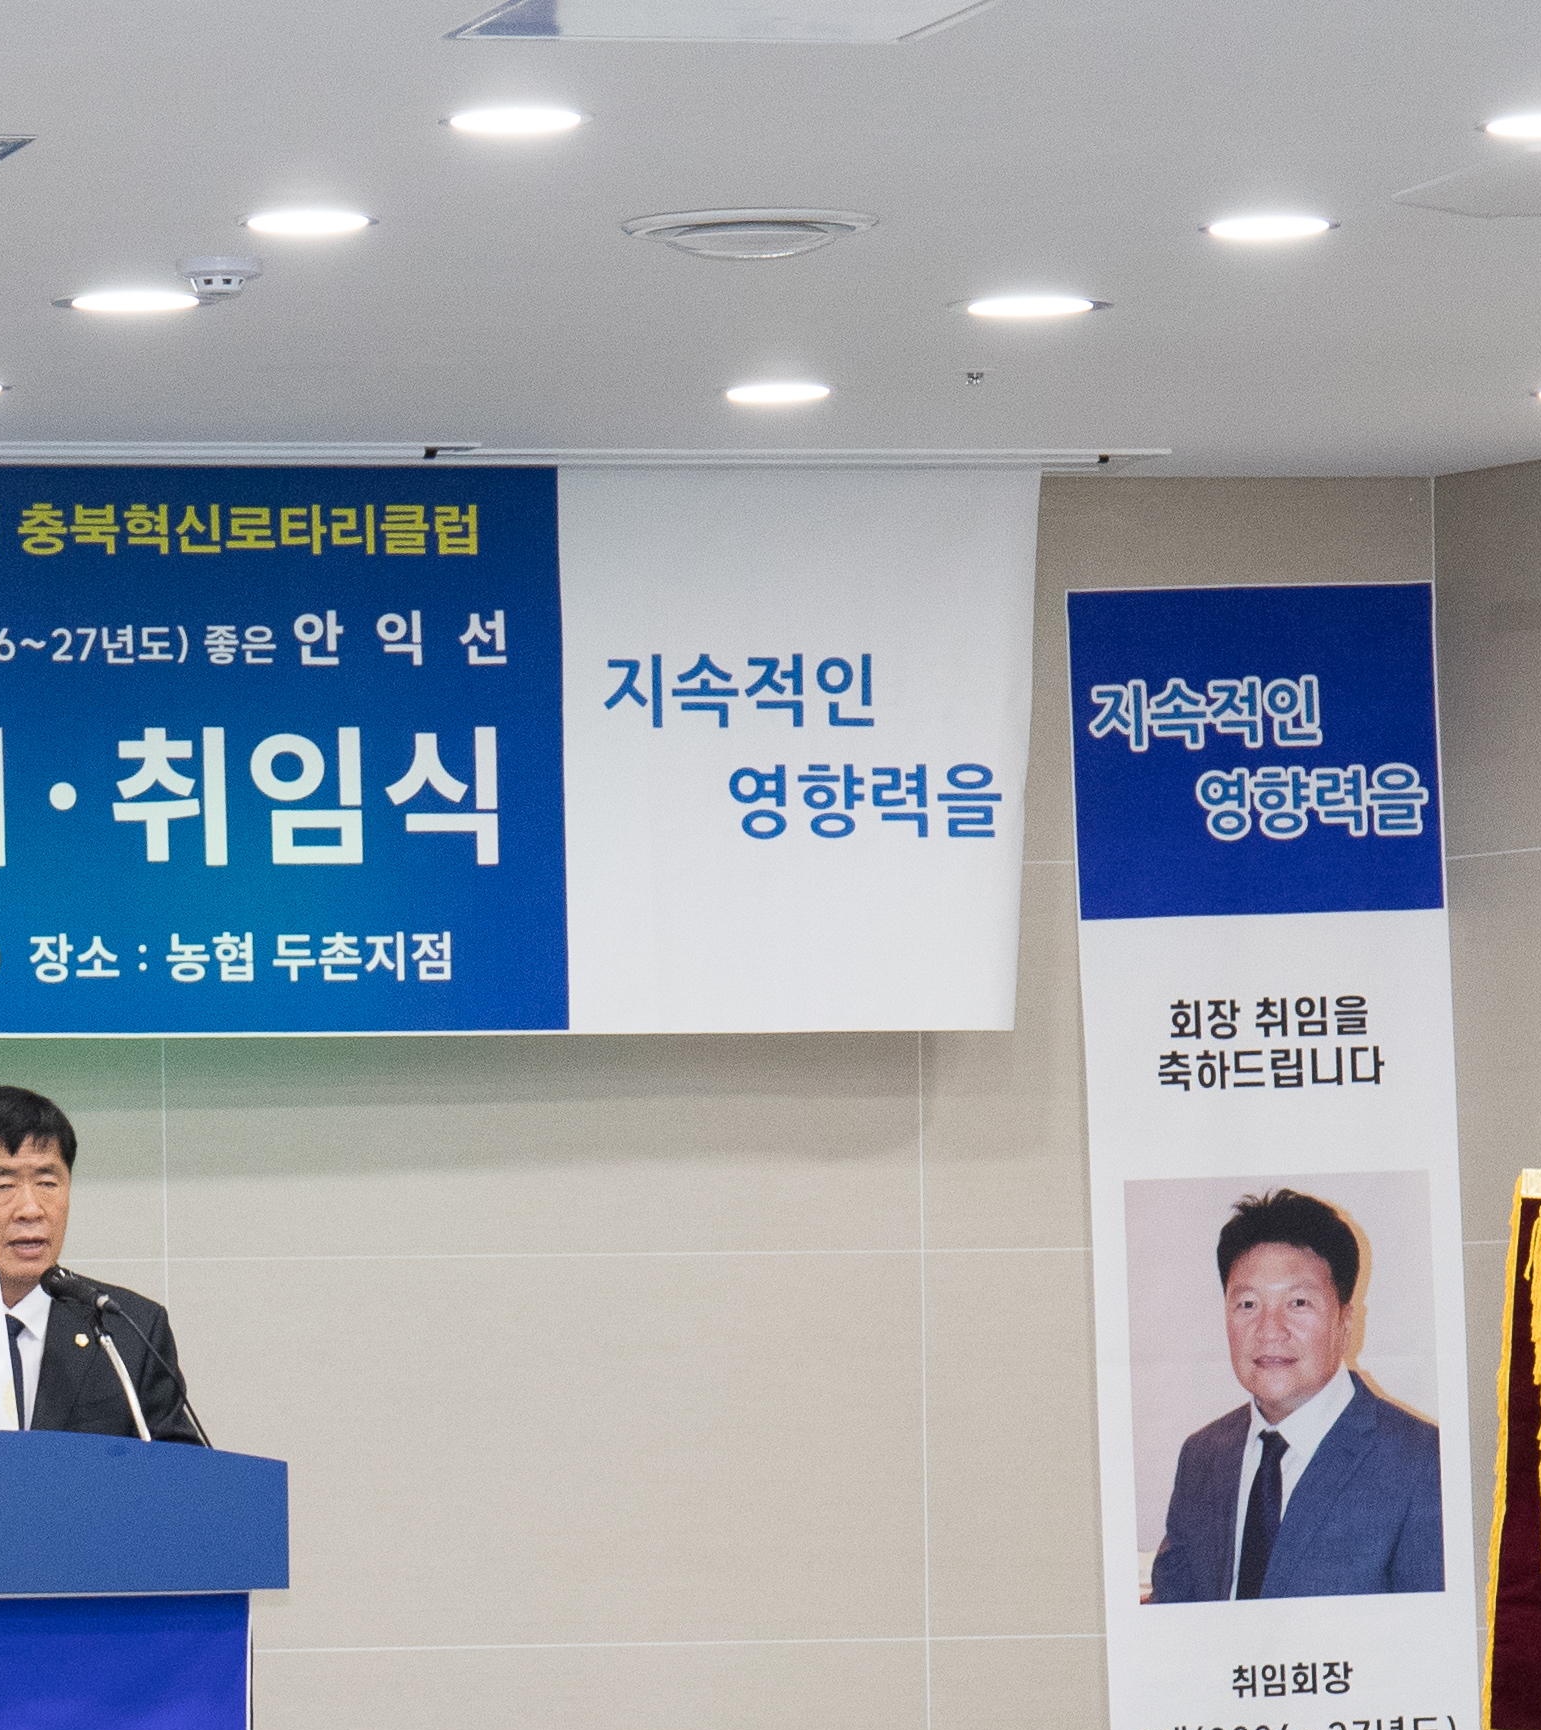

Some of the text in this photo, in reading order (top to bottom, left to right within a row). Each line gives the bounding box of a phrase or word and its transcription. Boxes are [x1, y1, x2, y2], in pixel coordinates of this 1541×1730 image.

[18, 503, 478, 555] 충북혁신로타리클럽
[204, 625, 276, 665] 좋은
[604, 653, 874, 728] 지속적인
[1088, 675, 1322, 752] 지속적인
[729, 763, 1002, 839] 영향력을
[1196, 763, 1428, 841] 영향력을
[30, 933, 120, 983] 장소
[166, 932, 254, 982] 농협
[272, 931, 451, 982] 두촌지점
[1170, 995, 1368, 1040] 회장 취임을
[1158, 1046, 1385, 1091] 축하드립니다
[1232, 1661, 1353, 1698] 취임회장
